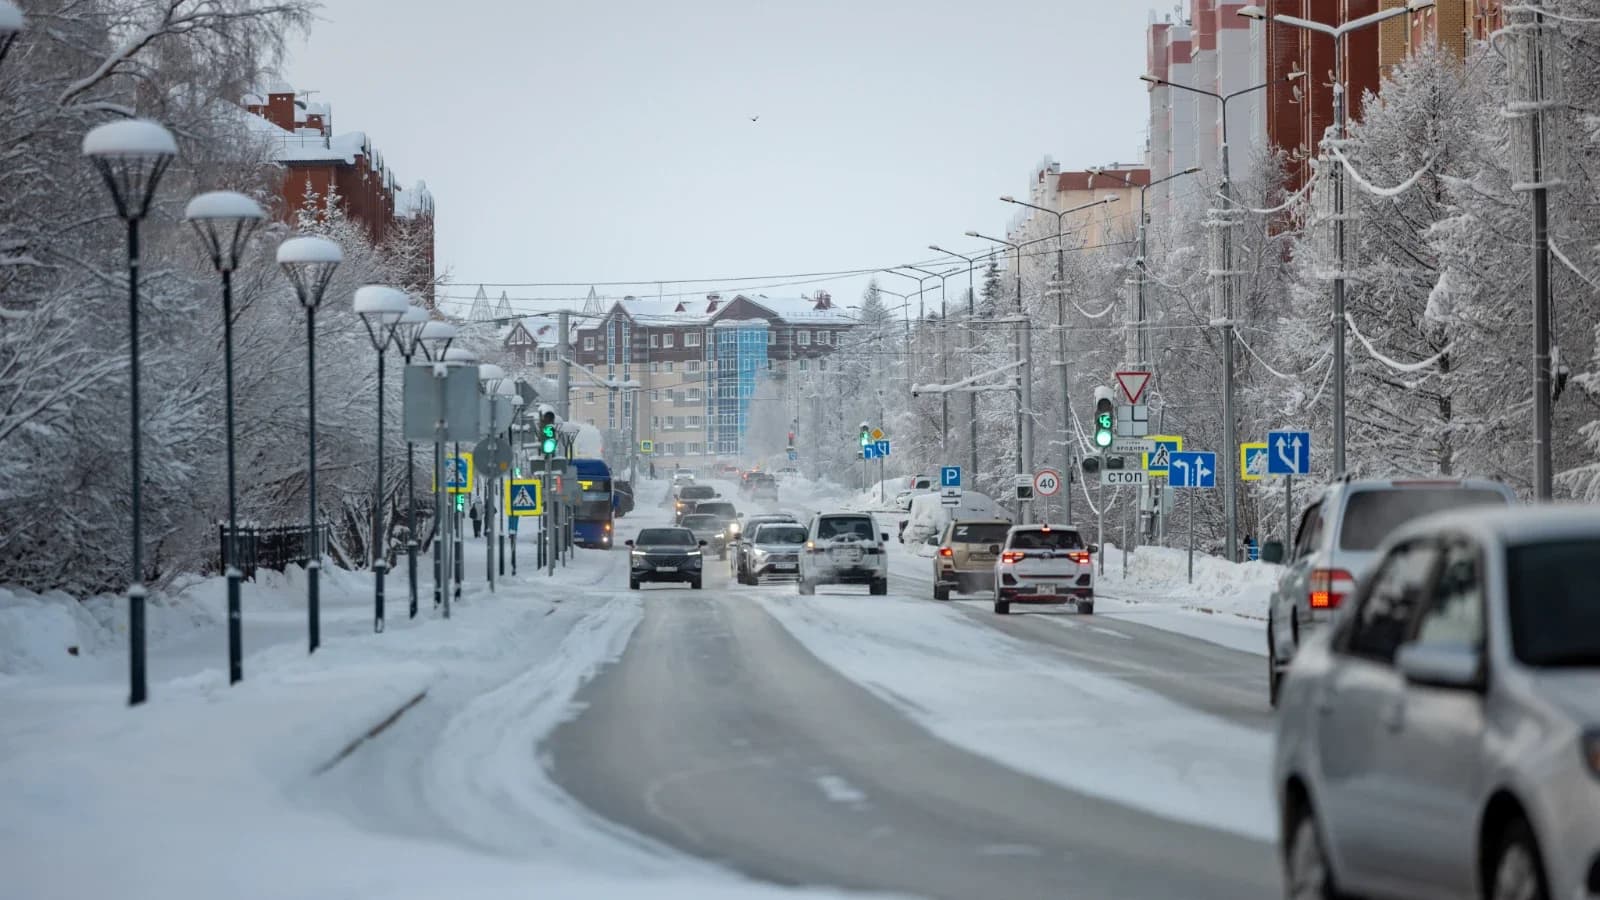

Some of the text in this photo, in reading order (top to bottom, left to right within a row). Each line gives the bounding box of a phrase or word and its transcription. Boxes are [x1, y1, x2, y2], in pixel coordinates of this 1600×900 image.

[946, 469, 958, 485] P
[1108, 472, 1142, 483] СТОП
[1040, 478, 1055, 489] 40
